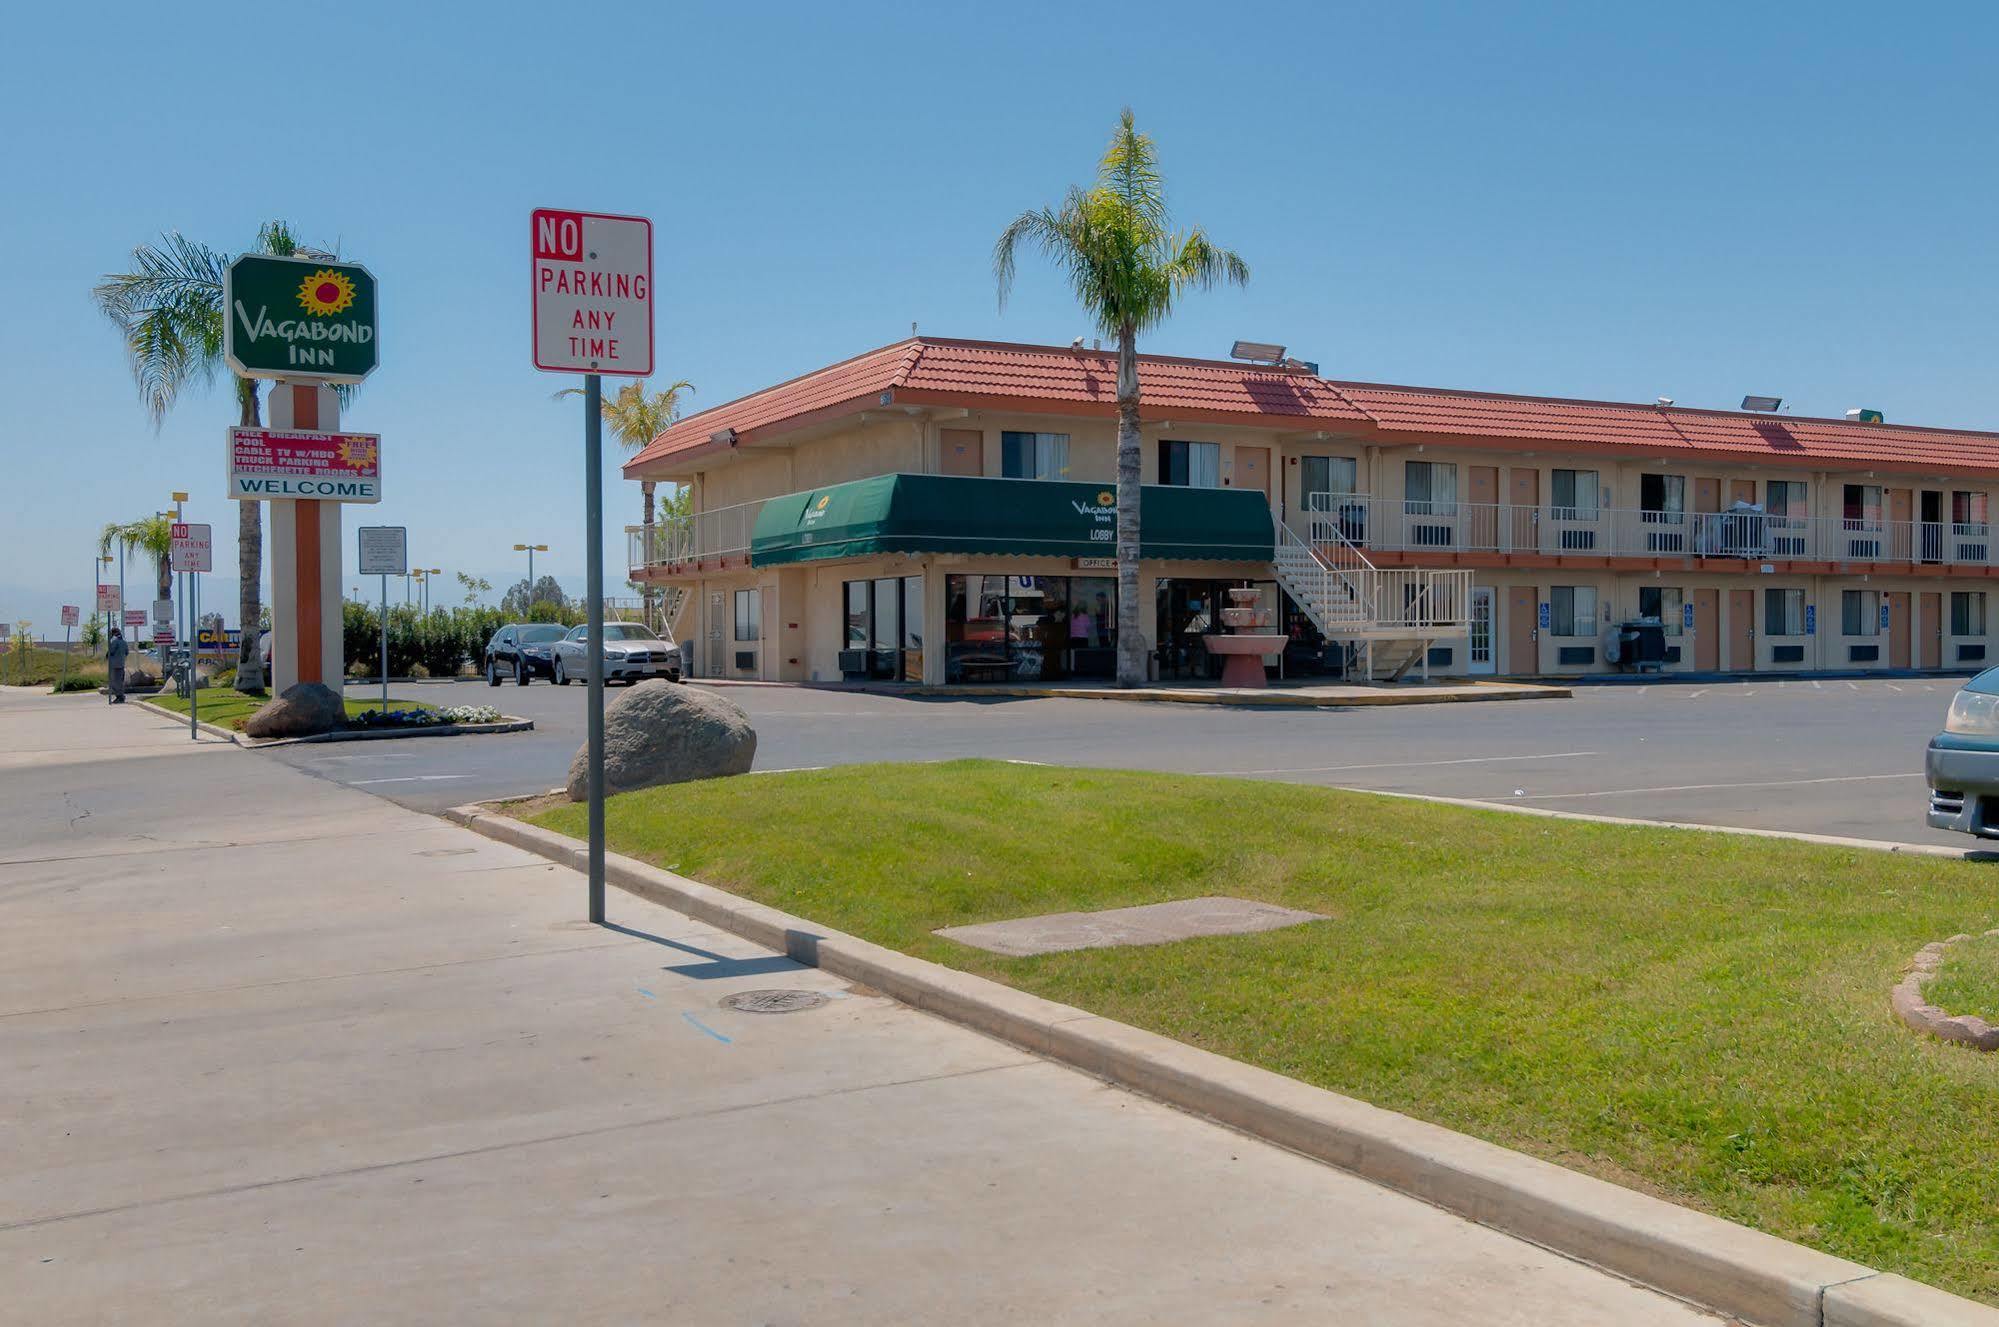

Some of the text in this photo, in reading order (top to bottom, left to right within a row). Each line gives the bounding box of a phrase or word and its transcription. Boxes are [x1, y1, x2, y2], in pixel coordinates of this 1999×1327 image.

[538, 216, 579, 256] NO
[541, 267, 646, 300] PARKING
[234, 299, 373, 344] VAGABOND
[572, 309, 616, 331] ANY
[289, 344, 335, 366] INN
[568, 336, 620, 360] TIME
[235, 438, 266, 447] POOL
[235, 446, 272, 456] CABLE
[276, 448, 291, 457] TV
[235, 456, 329, 467] TRUCK PARKING
[235, 465, 311, 475] KITCHENETTE
[240, 479, 374, 497] WELCOME
[1071, 500, 1119, 515] VAGABON
[173, 525, 187, 538] NO
[1090, 529, 1114, 541] LOBBY
[175, 541, 209, 549] PARKING
